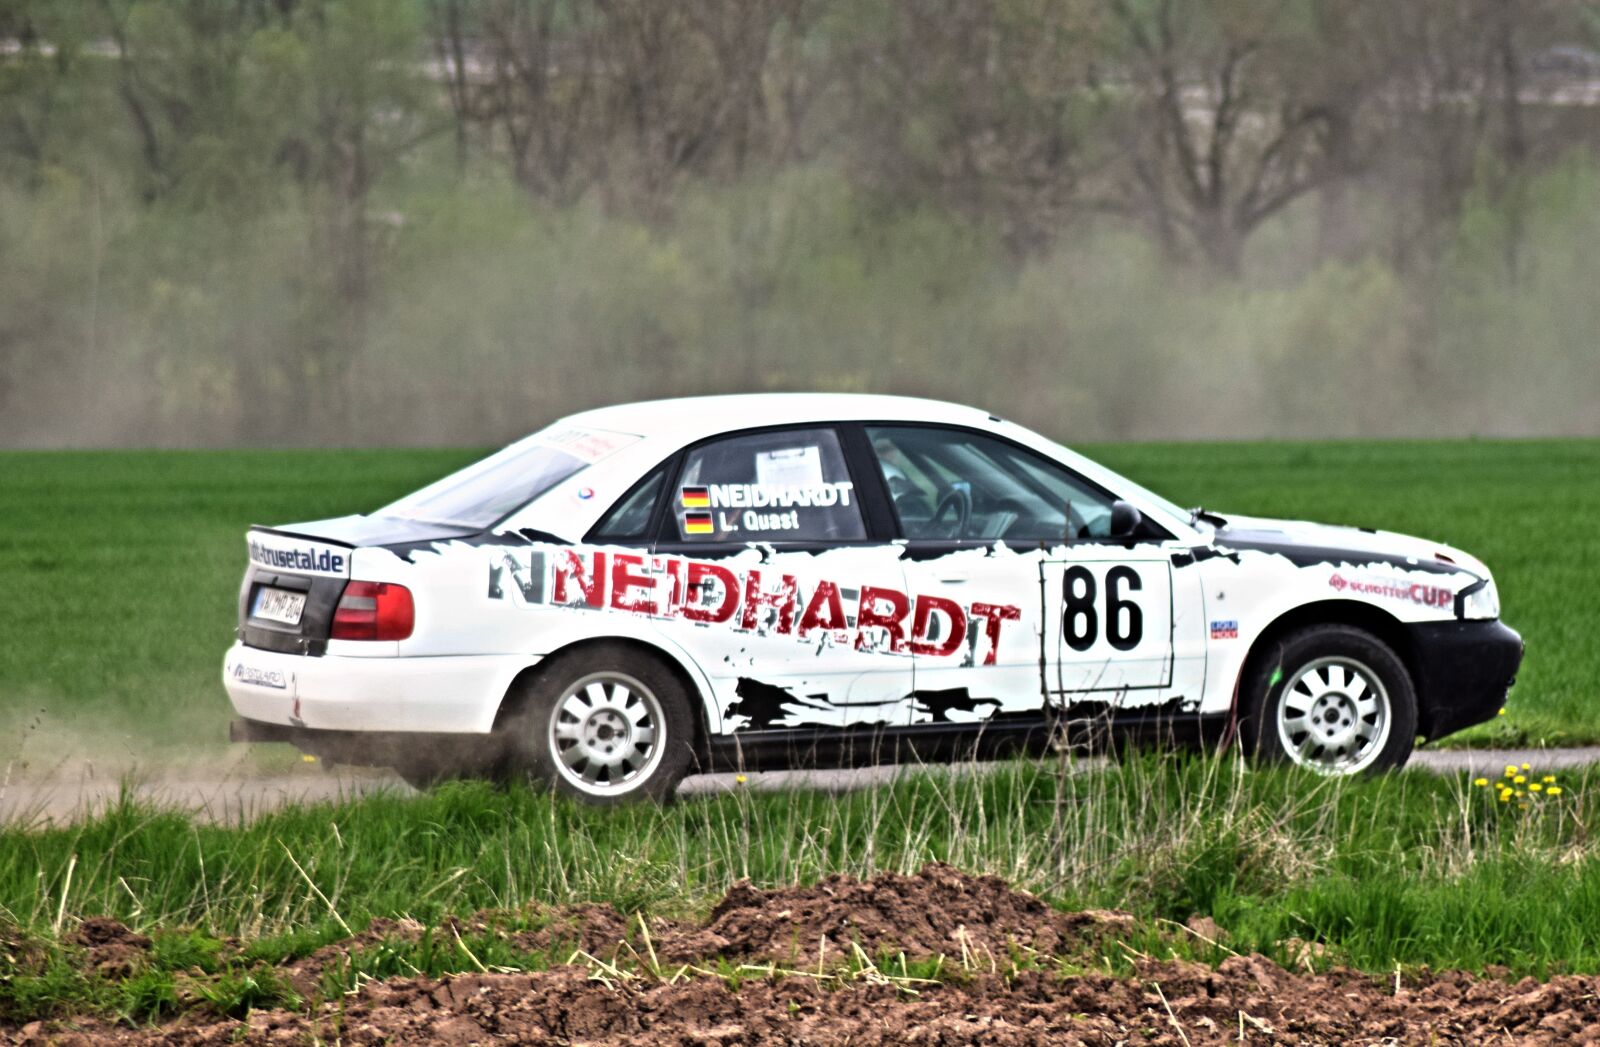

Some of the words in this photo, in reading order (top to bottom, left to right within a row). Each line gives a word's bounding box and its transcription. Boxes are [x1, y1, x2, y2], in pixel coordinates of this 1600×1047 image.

[709, 482, 853, 508] NEIDHARDT
[719, 511, 739, 532] L.
[743, 510, 800, 532] Quast
[1062, 564, 1144, 652] 86
